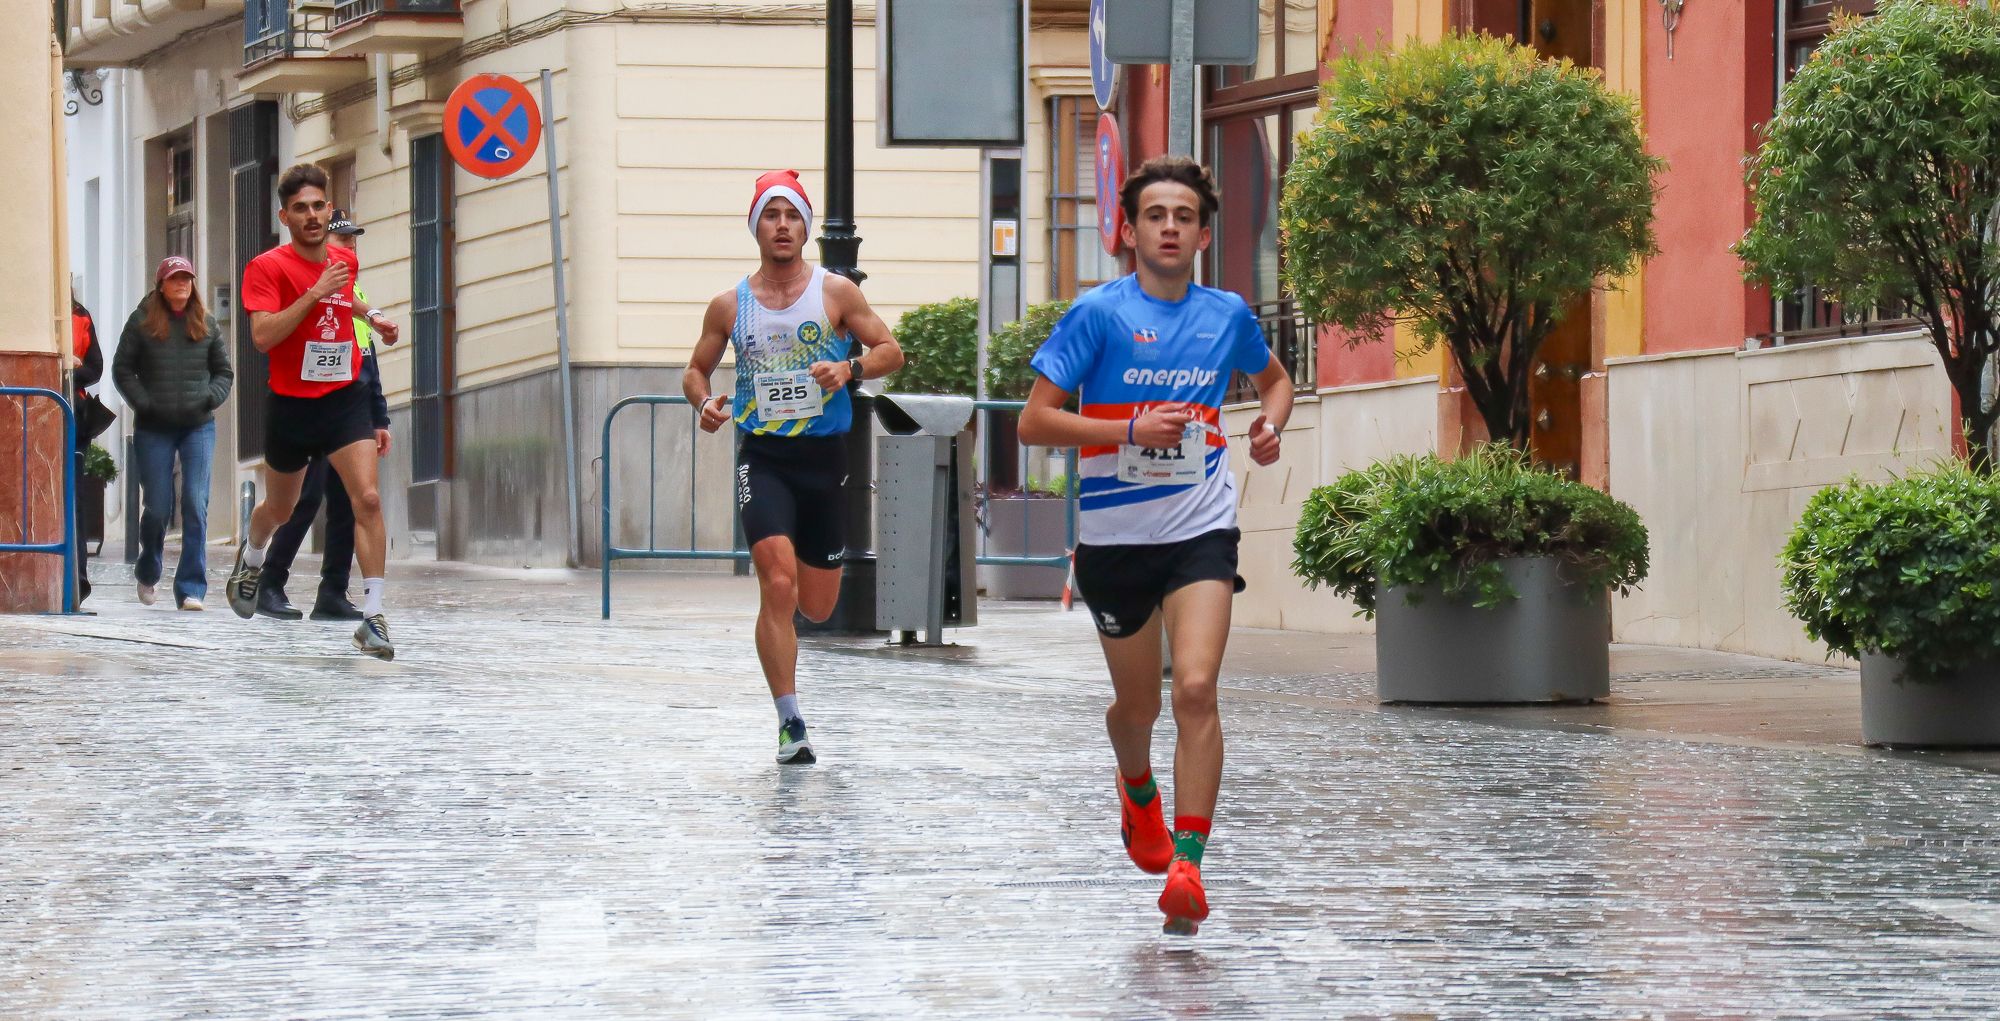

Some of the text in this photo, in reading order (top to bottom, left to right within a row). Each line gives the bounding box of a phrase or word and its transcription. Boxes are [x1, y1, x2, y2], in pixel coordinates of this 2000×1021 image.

[317, 355, 341, 366] 231
[1123, 367, 1218, 389] enerplus
[768, 385, 808, 402] 225
